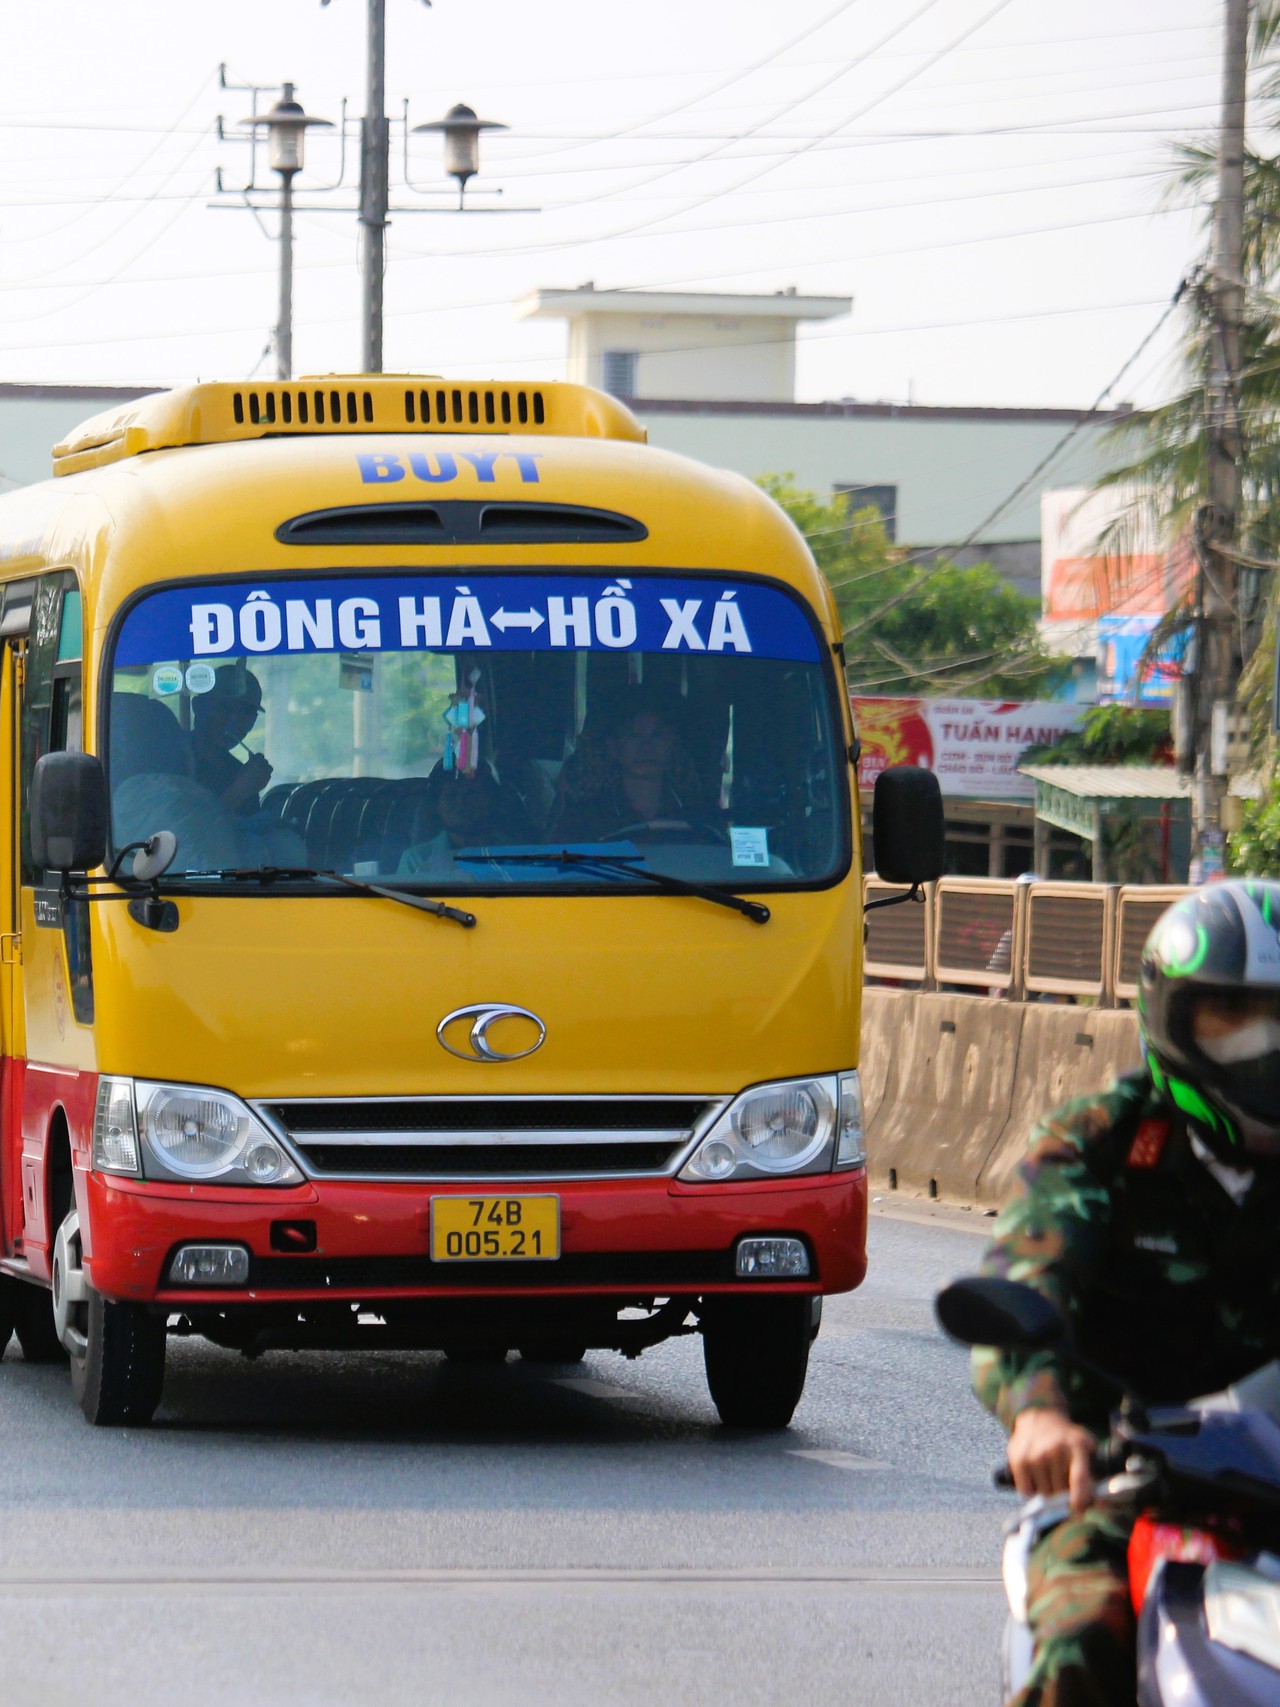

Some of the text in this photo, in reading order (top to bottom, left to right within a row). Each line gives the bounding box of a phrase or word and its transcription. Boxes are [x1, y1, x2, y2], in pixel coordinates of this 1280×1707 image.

[189, 578, 752, 654] ĐÔNG HÀ HỒ XÁ
[468, 1200, 522, 1226] 74B
[446, 1230, 541, 1256] 005.21
